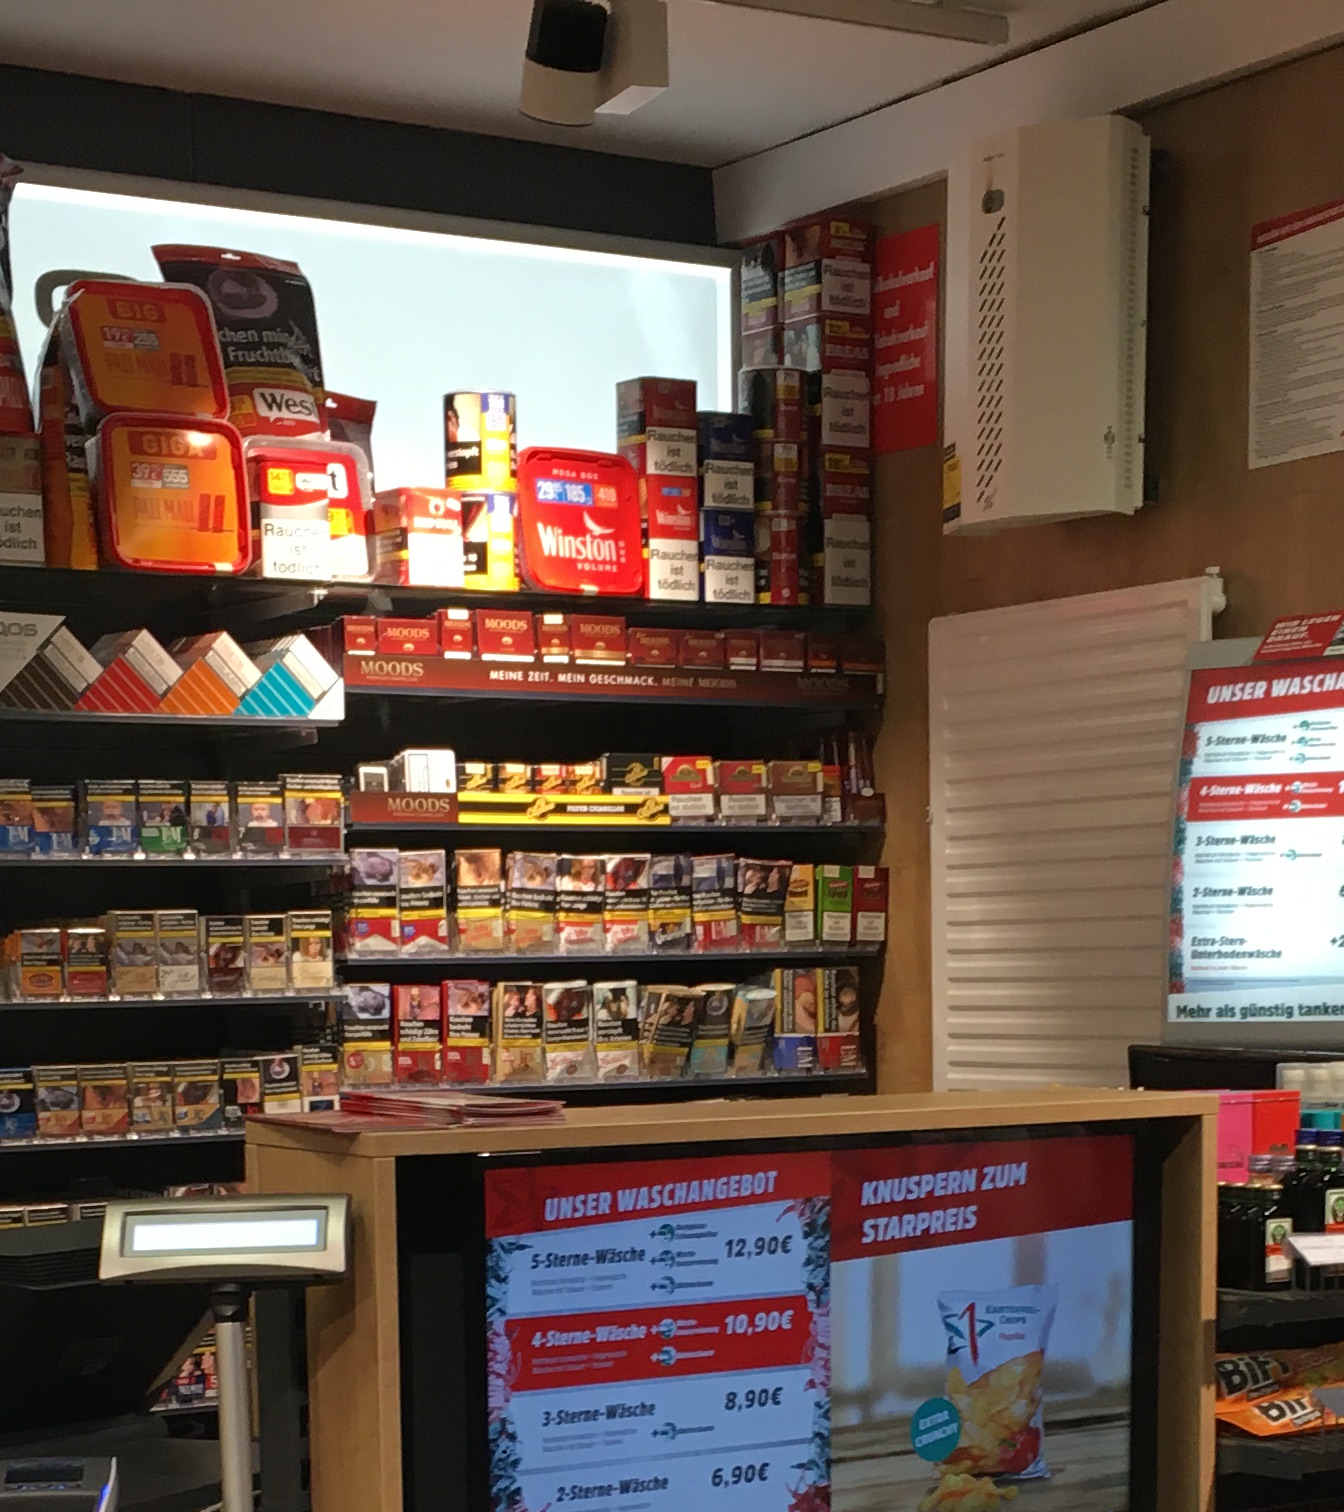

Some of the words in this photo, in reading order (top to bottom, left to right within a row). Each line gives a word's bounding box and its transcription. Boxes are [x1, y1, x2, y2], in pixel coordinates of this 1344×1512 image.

[667, 446, 681, 457] ist
[654, 460, 693, 473] tödlich
[4, 523, 22, 534] ist
[537, 522, 617, 562] Winston
[670, 565, 684, 576] ist
[657, 579, 696, 591] tödlich
[725, 576, 739, 586] ist
[713, 589, 751, 600] tödlich
[485, 618, 528, 632] MOODS
[360, 661, 424, 677] MOODS
[489, 670, 524, 682] MEINE
[528, 671, 555, 683] ZEIT.
[558, 673, 585, 684] MEIN
[589, 674, 658, 686] GESCHMACK.
[1206, 679, 1268, 705] UNSER
[1206, 732, 1287, 747] 5-Sterne-Wäsche
[1200, 782, 1282, 796] 4-Sterne-Wäsche
[387, 798, 450, 813] MOODS
[1195, 834, 1276, 847] 3-Sterne-Wäsche
[1192, 886, 1273, 898] 2-Sterne-Wäsche
[1190, 936, 1248, 948] Extra-Stern-
[1190, 949, 1282, 960] Unterbodenwäsche
[1175, 1002, 1211, 1019] Mehr
[1215, 1003, 1237, 1018] als
[1240, 1002, 1294, 1021] günstig
[861, 1169, 978, 1206] KNUSPERN
[981, 1162, 1028, 1190] ZUM
[544, 1192, 611, 1221] UNSER
[617, 1171, 778, 1212] WASCHANGEBOT
[861, 1205, 978, 1244] STARPREIS
[530, 1246, 646, 1270] 5-Sterne-Wäsche
[724, 1235, 793, 1260] 12,90€
[531, 1324, 647, 1347] 4-Sterne-Wäsche
[724, 1310, 795, 1336] 10,90€
[542, 1402, 656, 1427] 3-Sterne-Wäsche
[724, 1386, 783, 1411] 8,90€
[556, 1476, 669, 1502] 2-Sterne-Wäsche
[711, 1462, 771, 1489] 6,90€
